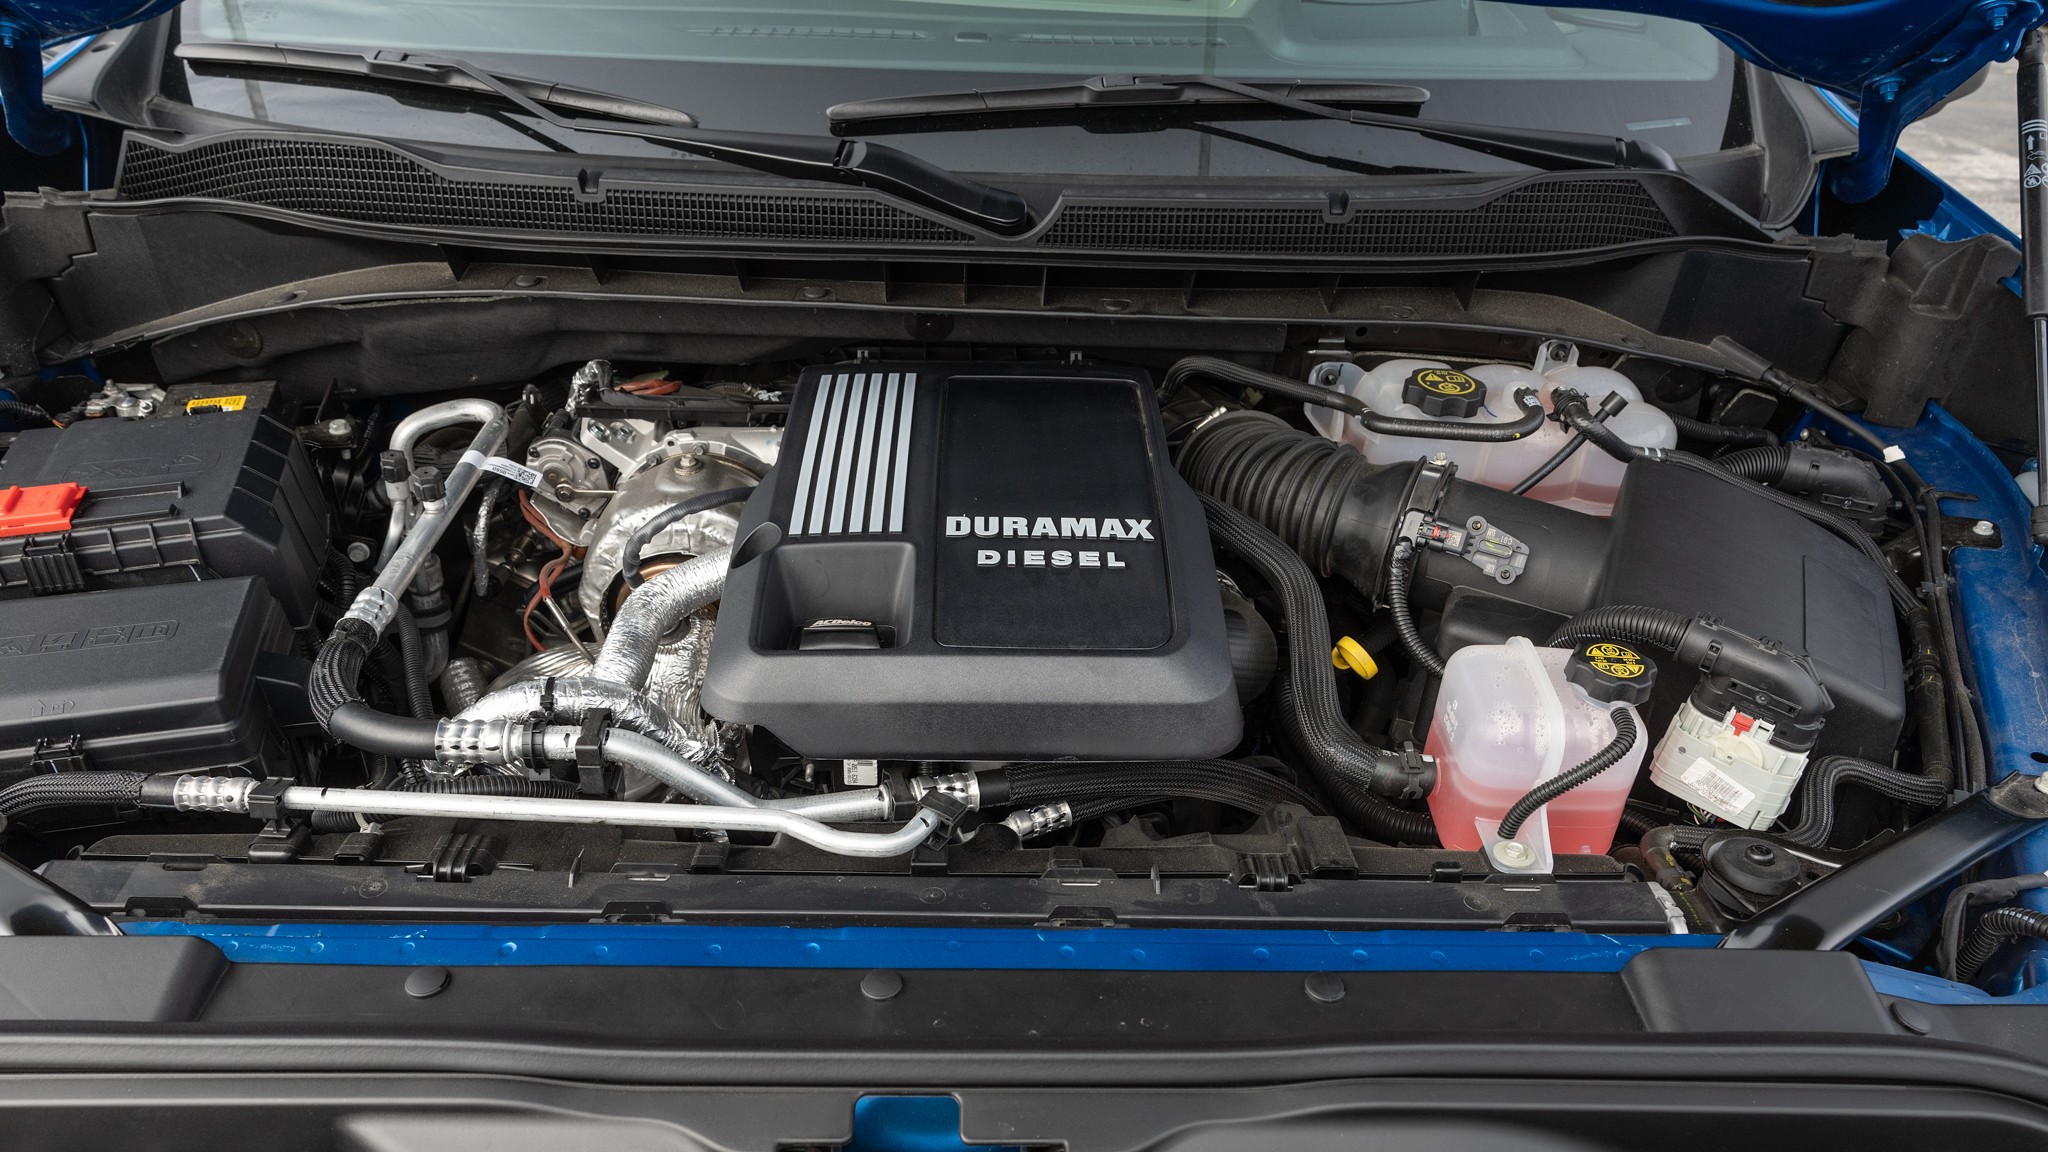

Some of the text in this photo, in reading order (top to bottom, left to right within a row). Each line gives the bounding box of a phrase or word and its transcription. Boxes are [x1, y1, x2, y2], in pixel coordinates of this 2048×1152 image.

[945, 515, 1155, 541] DURAMAX
[977, 550, 1126, 568] DIESEL
[809, 619, 872, 628] ACDelco
